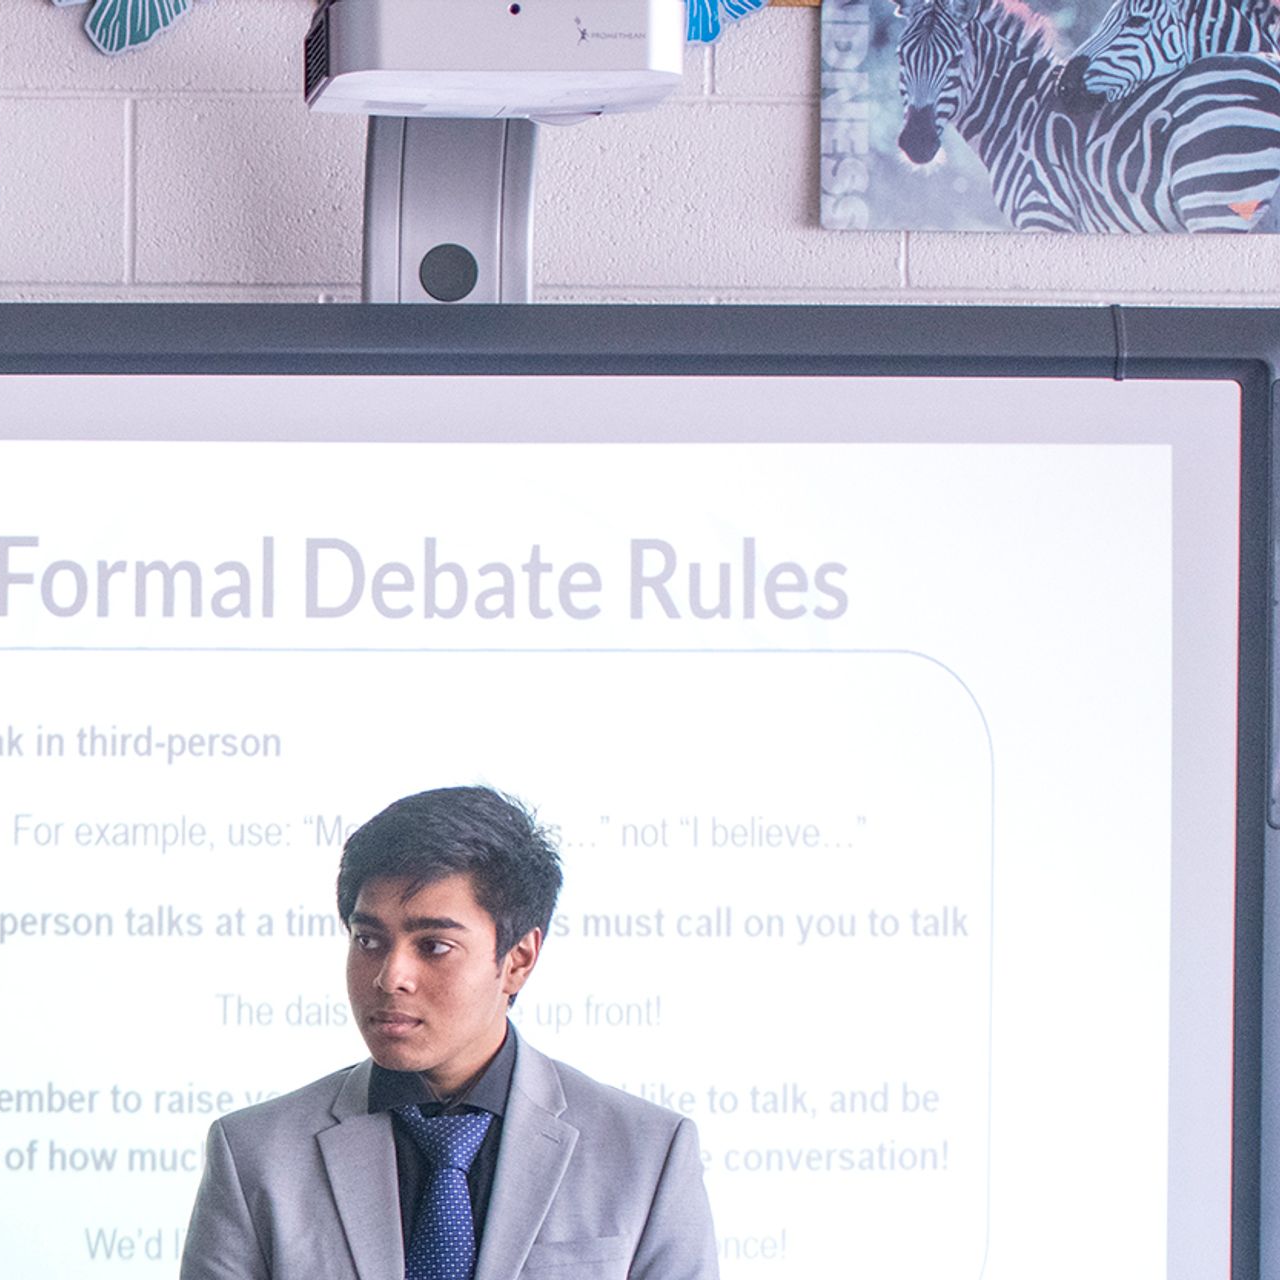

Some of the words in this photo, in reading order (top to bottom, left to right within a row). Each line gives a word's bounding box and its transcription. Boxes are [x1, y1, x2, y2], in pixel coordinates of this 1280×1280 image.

[305, 536, 604, 621] Debate
[630, 537, 850, 621] Rules
[37, 725, 65, 758] in
[76, 726, 282, 766] third-person
[14, 813, 65, 847] For
[75, 814, 216, 851] example,
[228, 822, 293, 848] use:
[622, 818, 670, 849] not
[0, 912, 115, 945] person
[125, 905, 204, 938] talks
[217, 908, 247, 937] at
[256, 913, 276, 938] a
[582, 909, 666, 939] must
[676, 906, 733, 939] call
[744, 914, 785, 939] on
[796, 914, 857, 947] you
[868, 909, 901, 939] to
[909, 905, 969, 938] talk
[215, 993, 276, 1028] The
[285, 994, 346, 1028] dais
[536, 1002, 574, 1035] up
[584, 994, 663, 1028] front!
[110, 1084, 144, 1115] to
[154, 1081, 234, 1115] raise
[707, 1085, 740, 1114] to
[749, 1082, 817, 1119] talk,
[829, 1082, 891, 1115] and
[901, 1081, 941, 1115] be
[4, 1138, 40, 1173] of
[48, 1138, 119, 1174] how
[724, 1139, 950, 1173] conversation!
